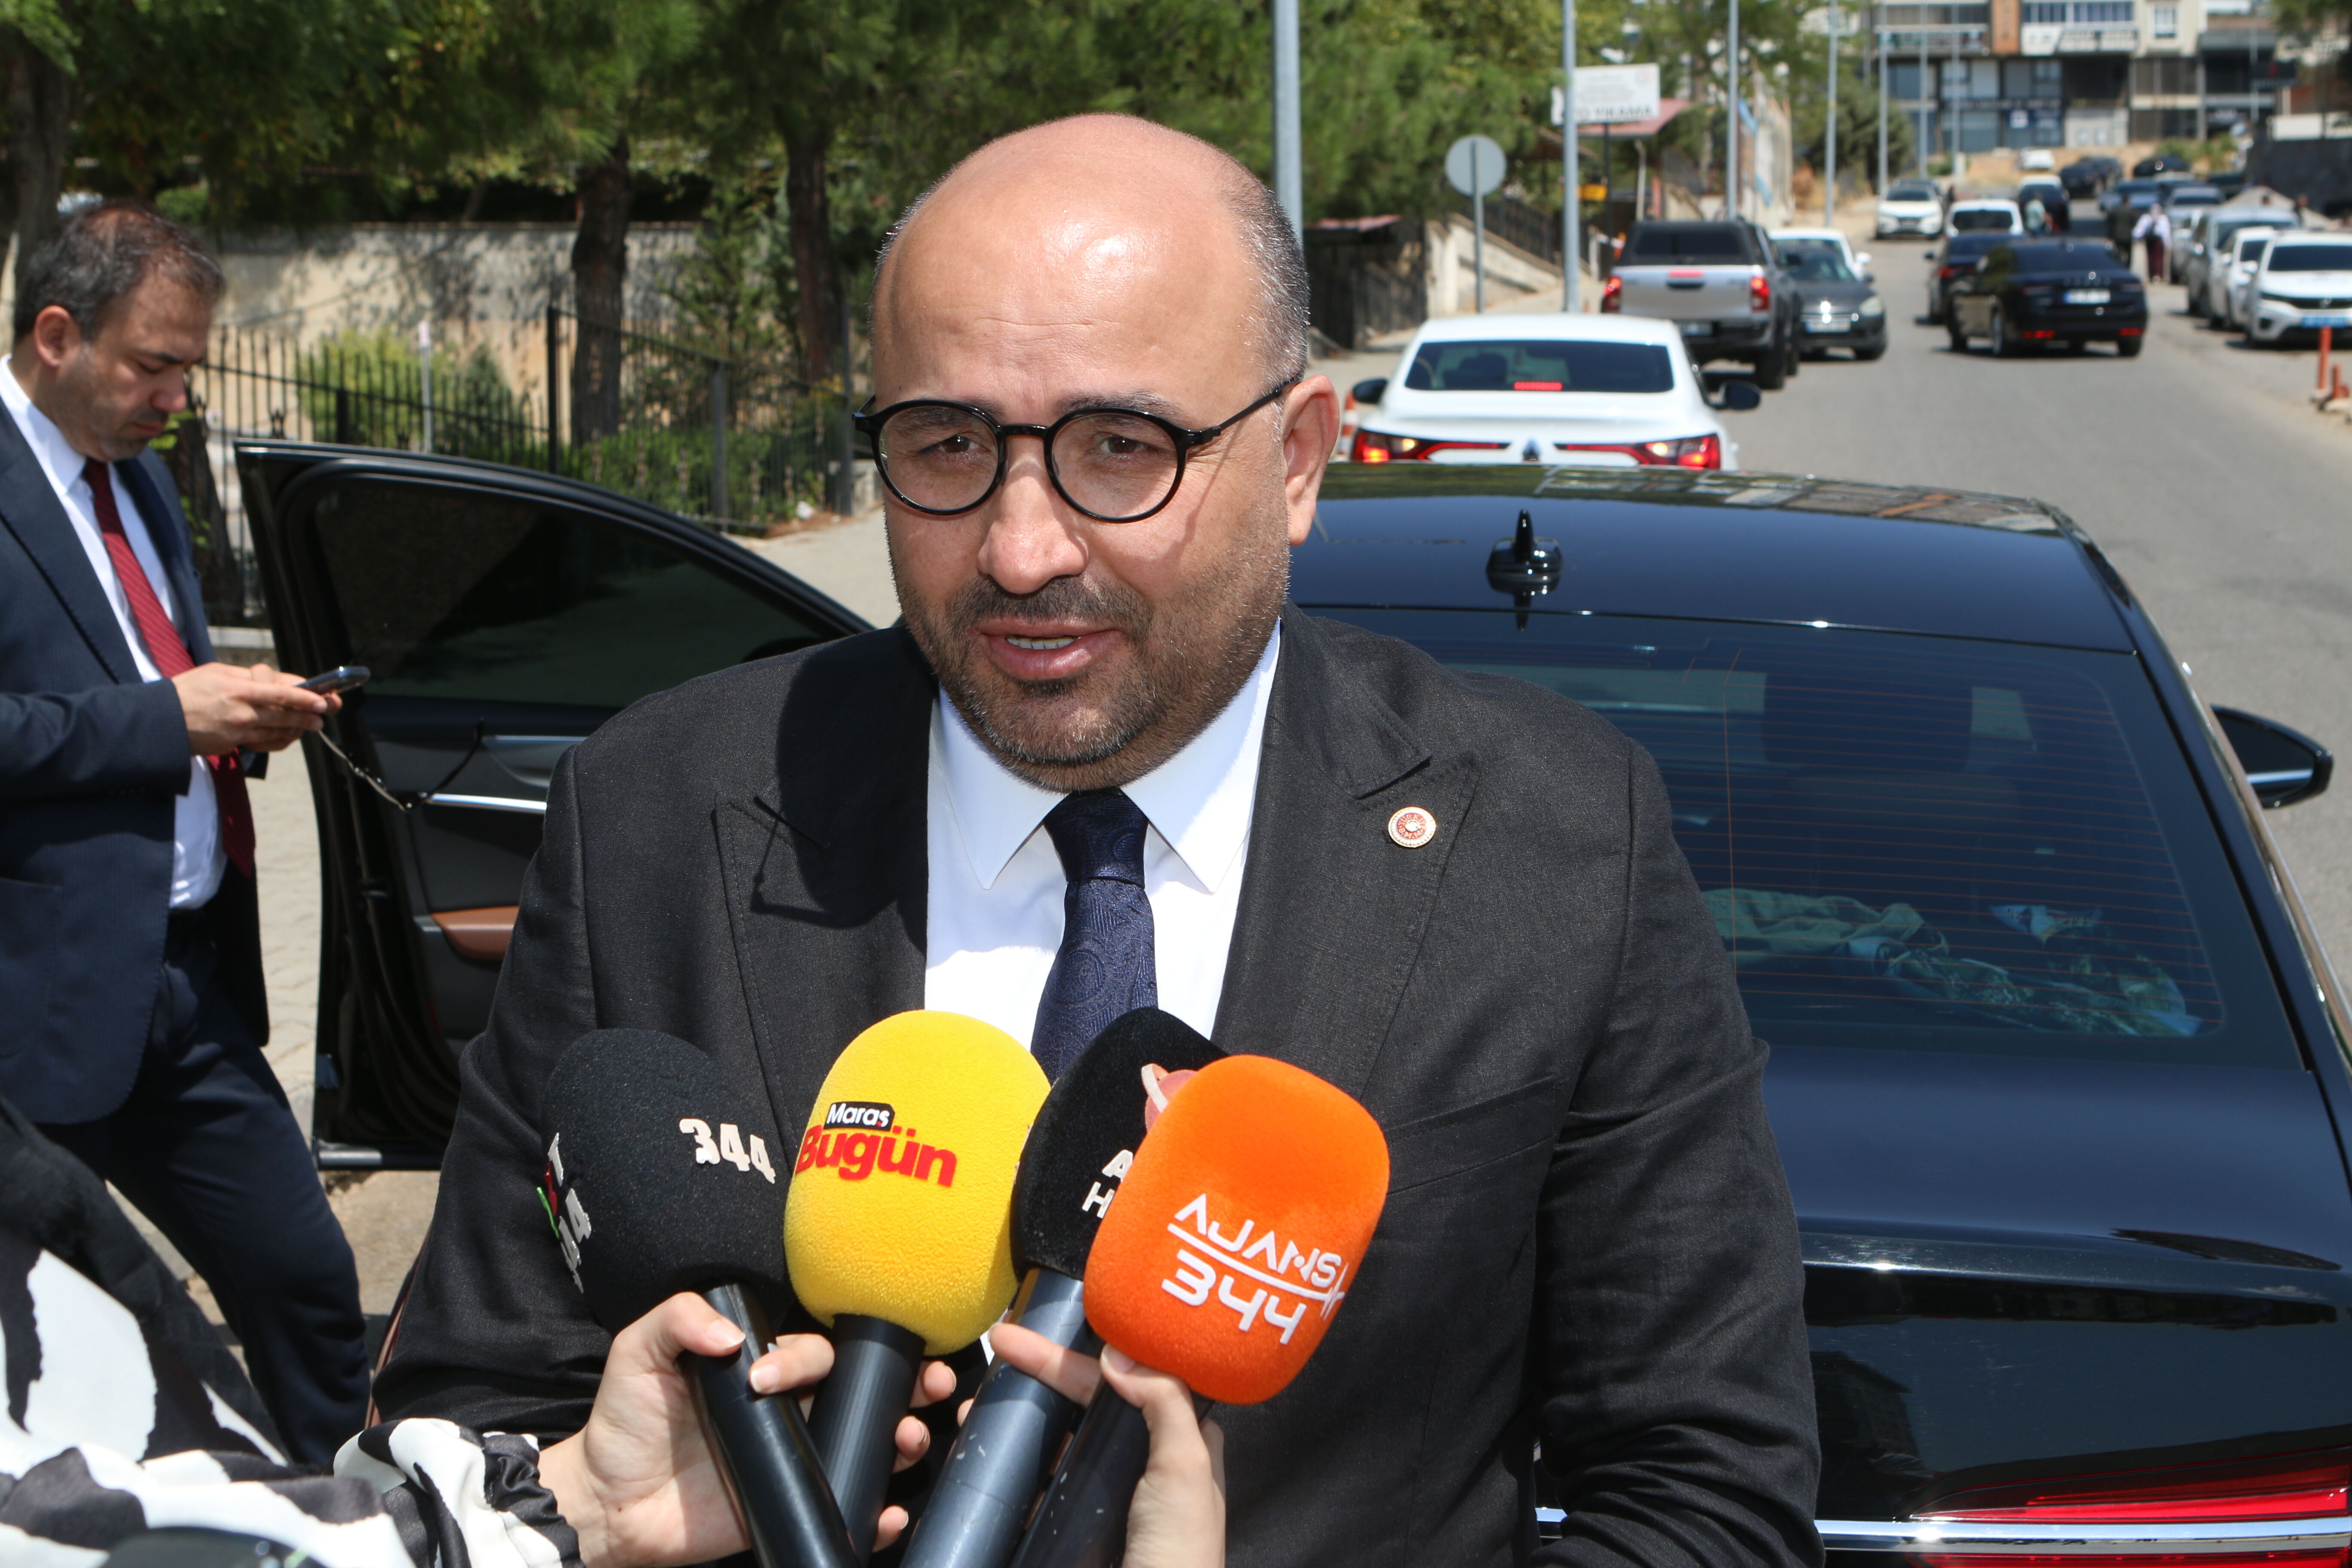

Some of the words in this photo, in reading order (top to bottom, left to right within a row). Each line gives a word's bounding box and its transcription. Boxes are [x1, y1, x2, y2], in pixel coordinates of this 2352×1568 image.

[826, 1103, 890, 1128] Maraş
[679, 1118, 776, 1184] 344
[795, 1124, 957, 1187] Bugün
[1174, 1193, 1342, 1288] AJANS
[1161, 1249, 1307, 1344] 344
